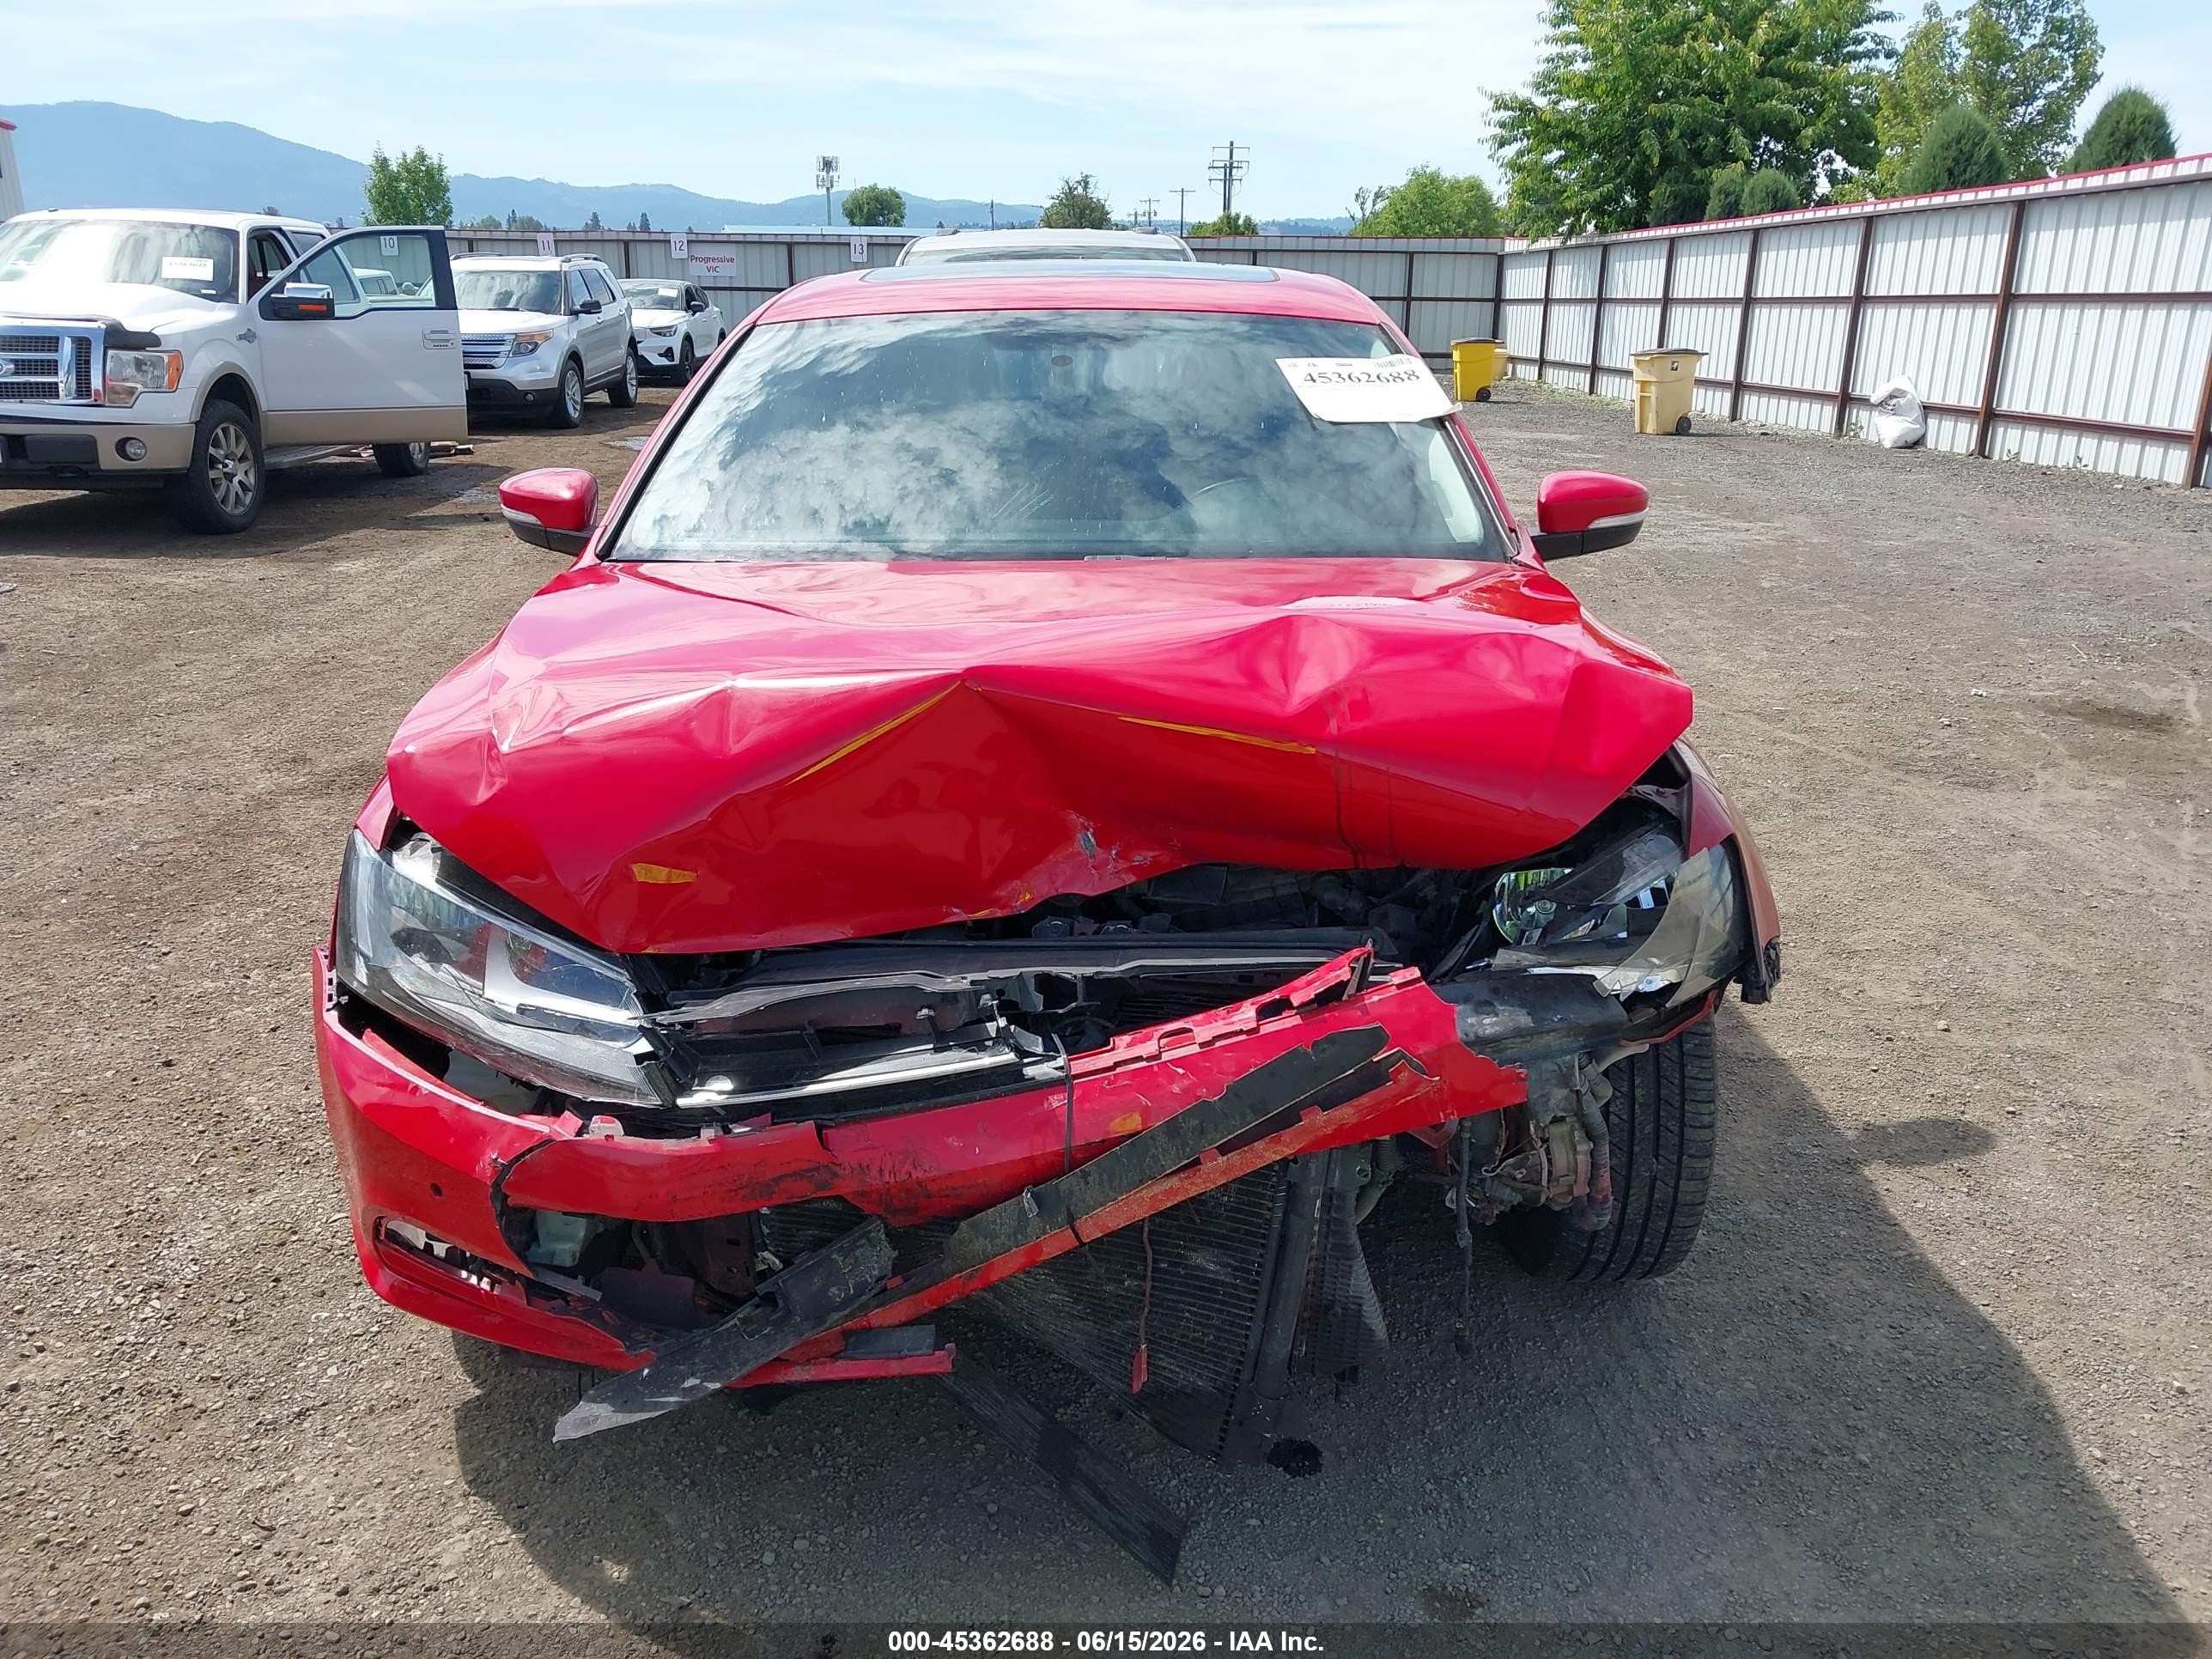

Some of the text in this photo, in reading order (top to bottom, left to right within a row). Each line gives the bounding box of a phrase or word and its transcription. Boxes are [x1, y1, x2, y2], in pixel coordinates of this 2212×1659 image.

[383, 237, 395, 248] 10
[542, 240, 550, 251] 11
[673, 240, 685, 252] 12
[854, 243, 865, 255] 13
[690, 254, 735, 264] Progressive
[1304, 369, 1420, 384] 45362688
